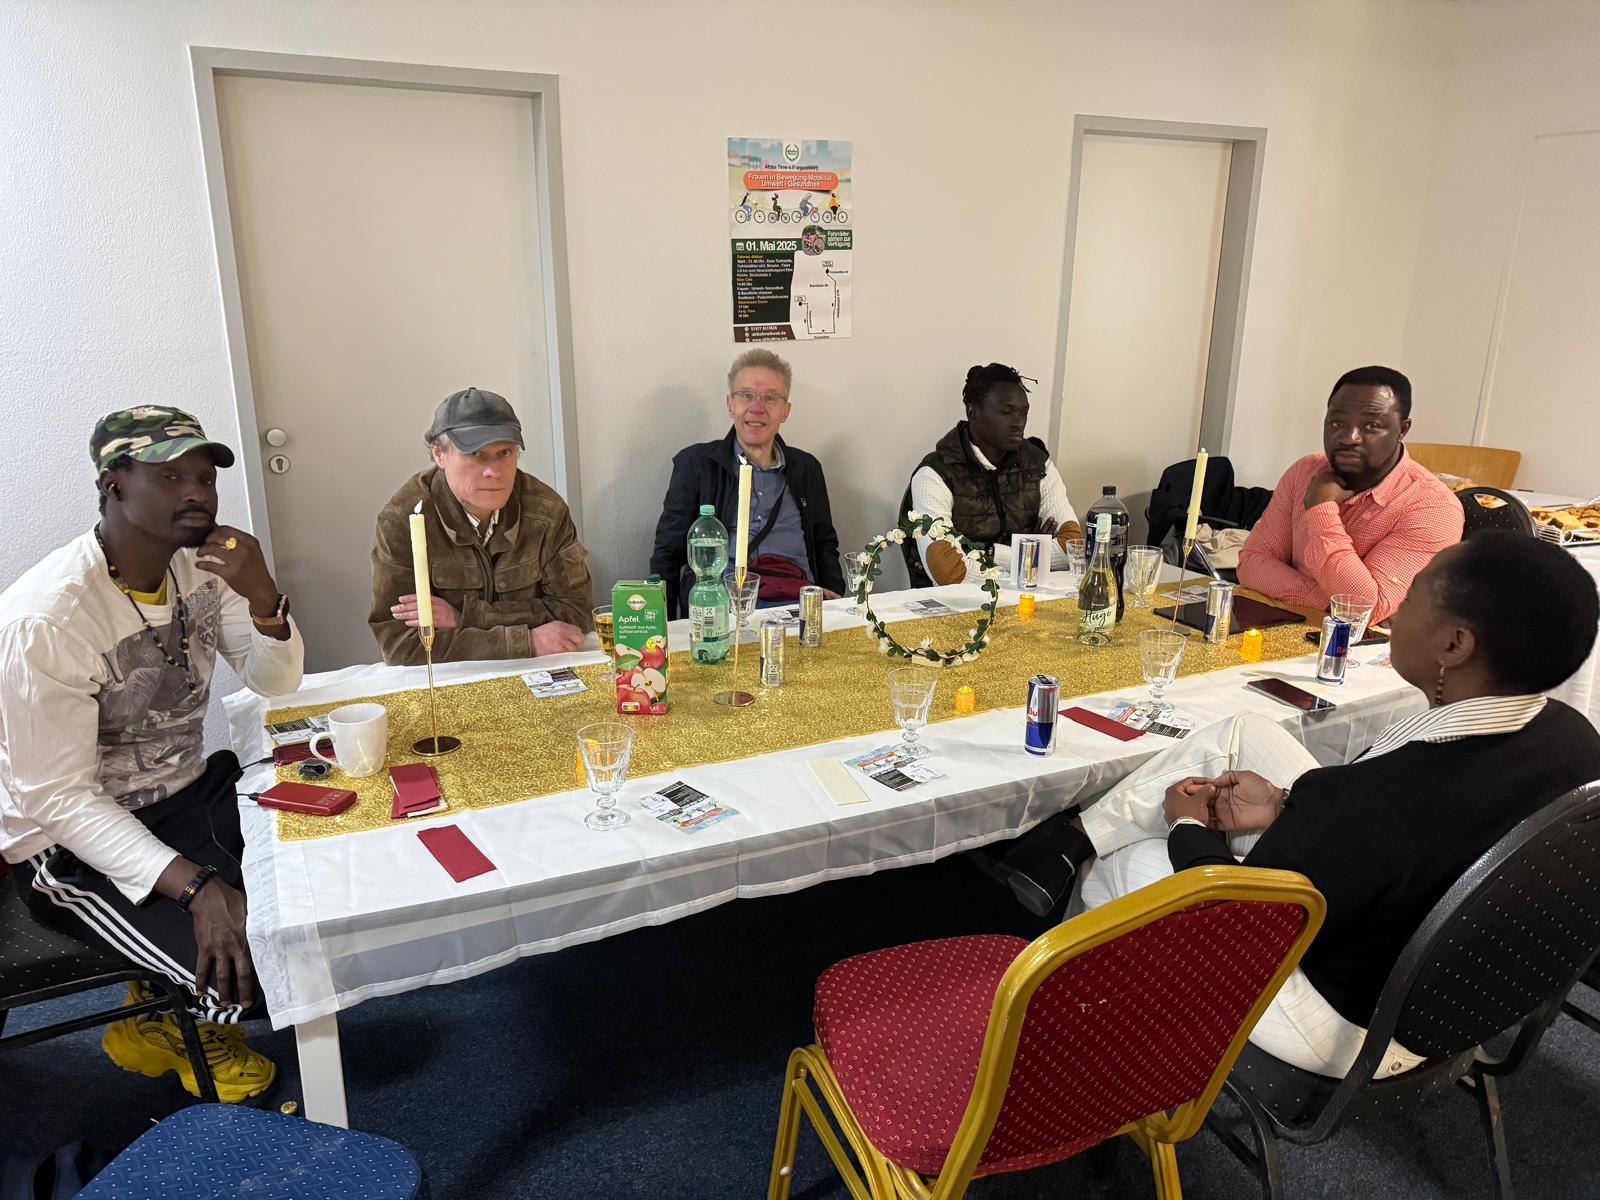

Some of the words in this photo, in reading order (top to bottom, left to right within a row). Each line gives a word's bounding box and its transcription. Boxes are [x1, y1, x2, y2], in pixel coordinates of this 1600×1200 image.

[746, 240, 759, 251] 01.
[760, 240, 776, 251] Mai
[776, 240, 797, 251] 2025
[618, 616, 640, 624] Apfel
[1082, 610, 1112, 628] Hugo
